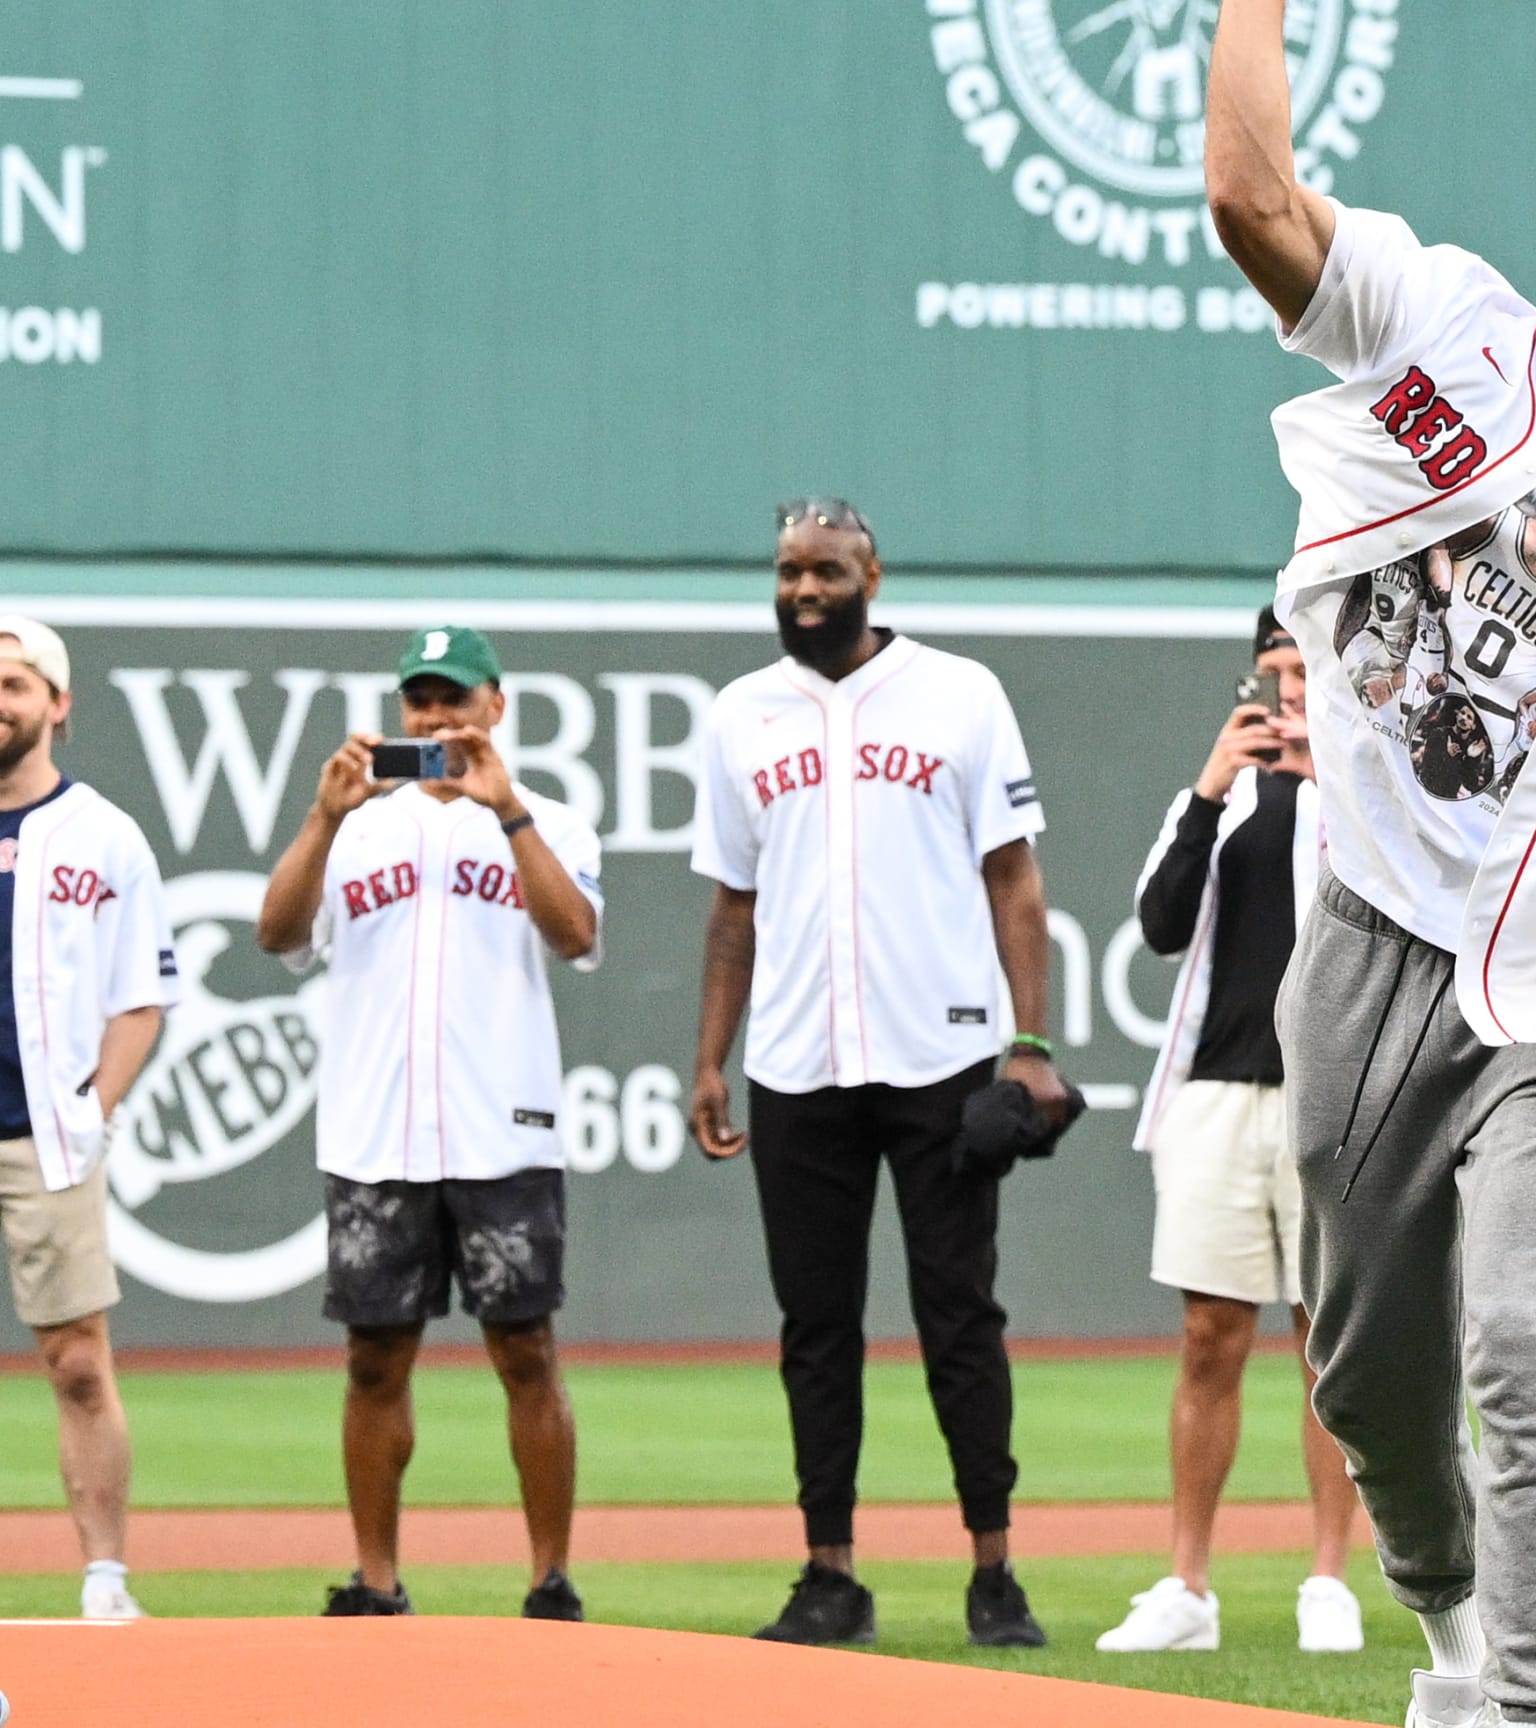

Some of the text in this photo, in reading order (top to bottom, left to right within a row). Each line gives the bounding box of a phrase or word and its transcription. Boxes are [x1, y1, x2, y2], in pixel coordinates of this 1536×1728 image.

[916, 281, 1186, 330] POWERING
[1370, 366, 1488, 491] RED
[1374, 562, 1417, 594] ELTICS
[1375, 593, 1395, 622] 9
[1464, 619, 1517, 679] 0
[753, 742, 943, 807] RED SOX
[343, 862, 417, 919] RED
[135, 1013, 318, 1160] WEBB
